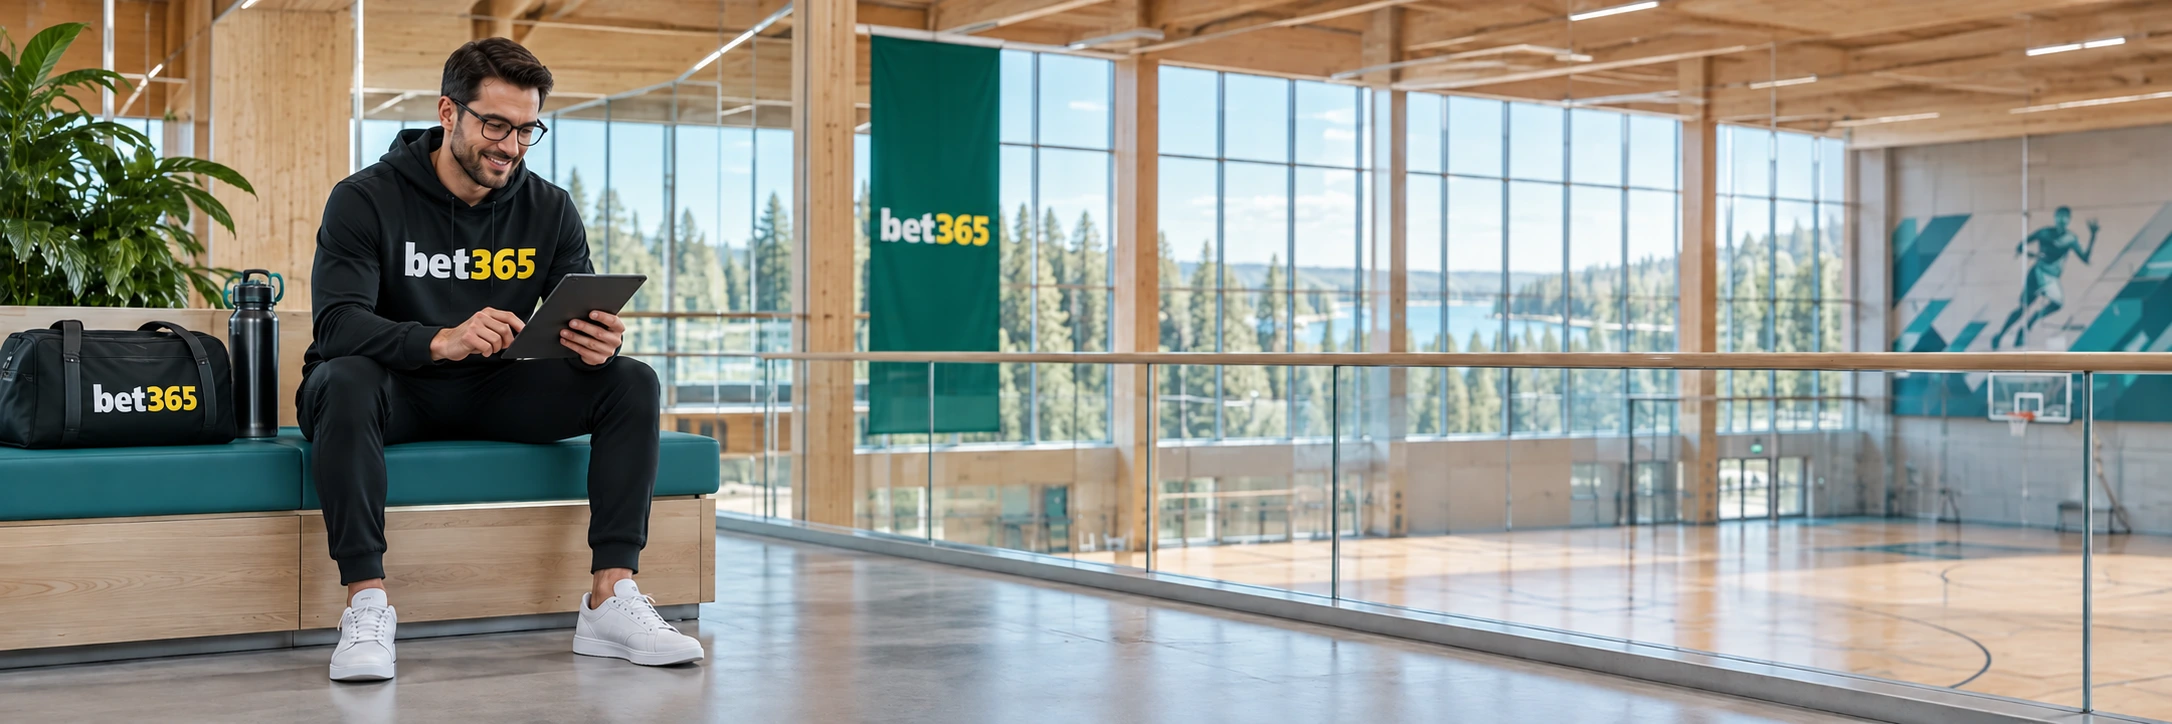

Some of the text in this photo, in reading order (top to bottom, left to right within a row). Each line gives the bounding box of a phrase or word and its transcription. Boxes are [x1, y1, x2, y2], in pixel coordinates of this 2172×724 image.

[880, 207, 989, 246] bet365
[404, 241, 536, 280] bet365
[93, 383, 197, 413] bet365
